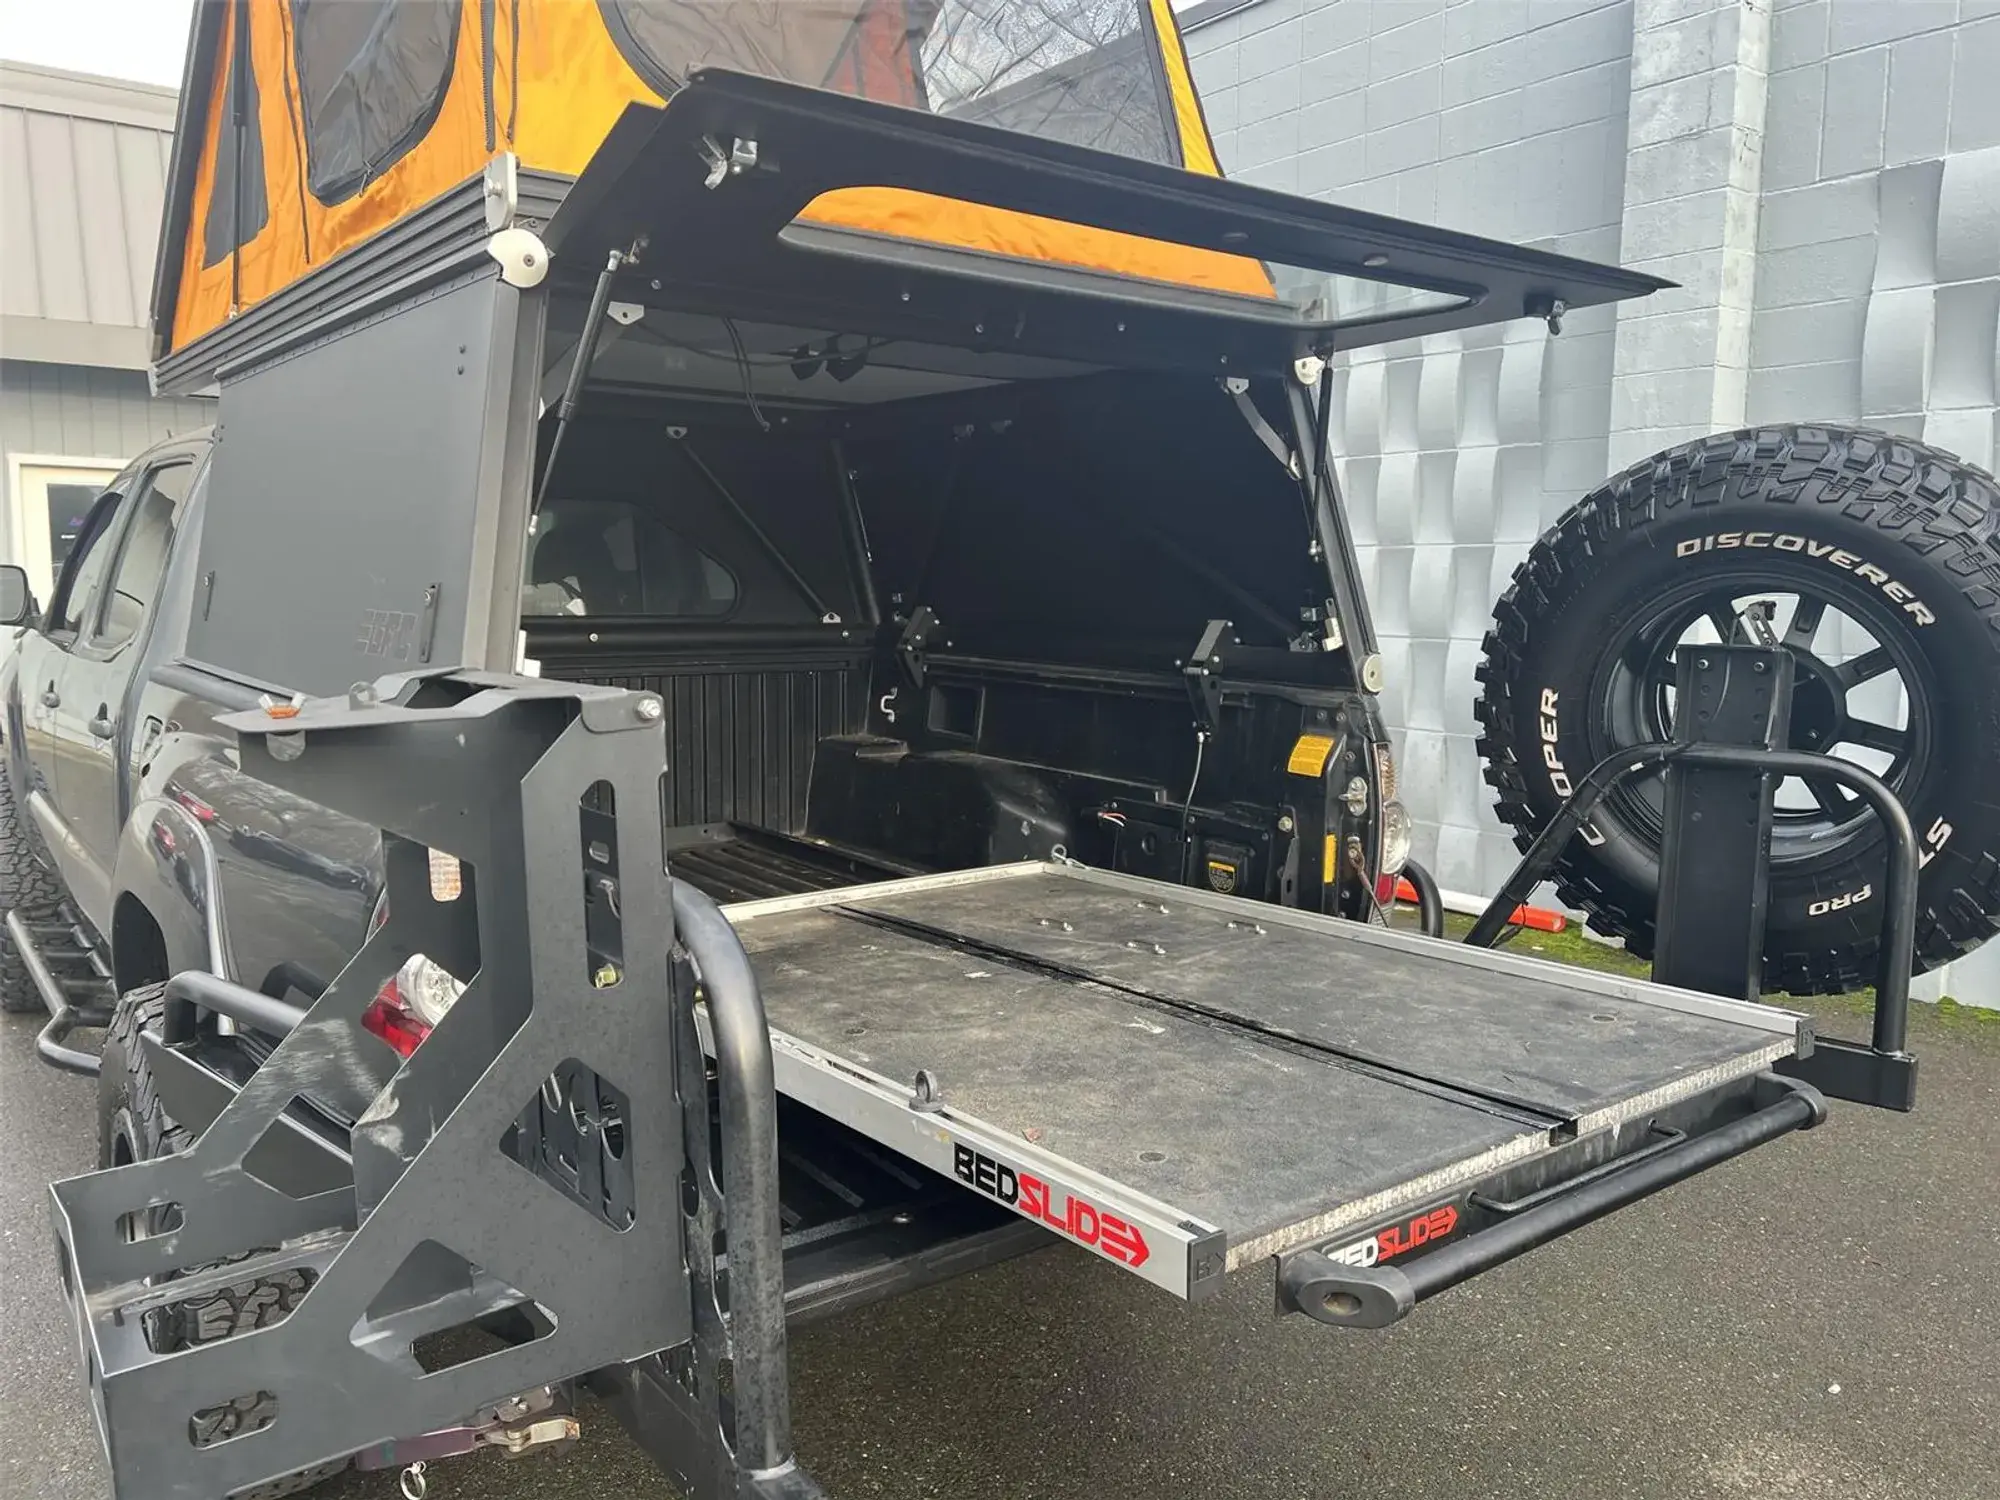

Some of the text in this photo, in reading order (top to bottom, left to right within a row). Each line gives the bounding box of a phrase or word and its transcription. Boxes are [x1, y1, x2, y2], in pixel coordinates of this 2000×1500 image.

[1677, 531, 1937, 627] DISCOVERER
[1540, 687, 1607, 847] COPER
[1808, 883, 1873, 916] PRO
[954, 1142, 1150, 1268] BEDSLIDE
